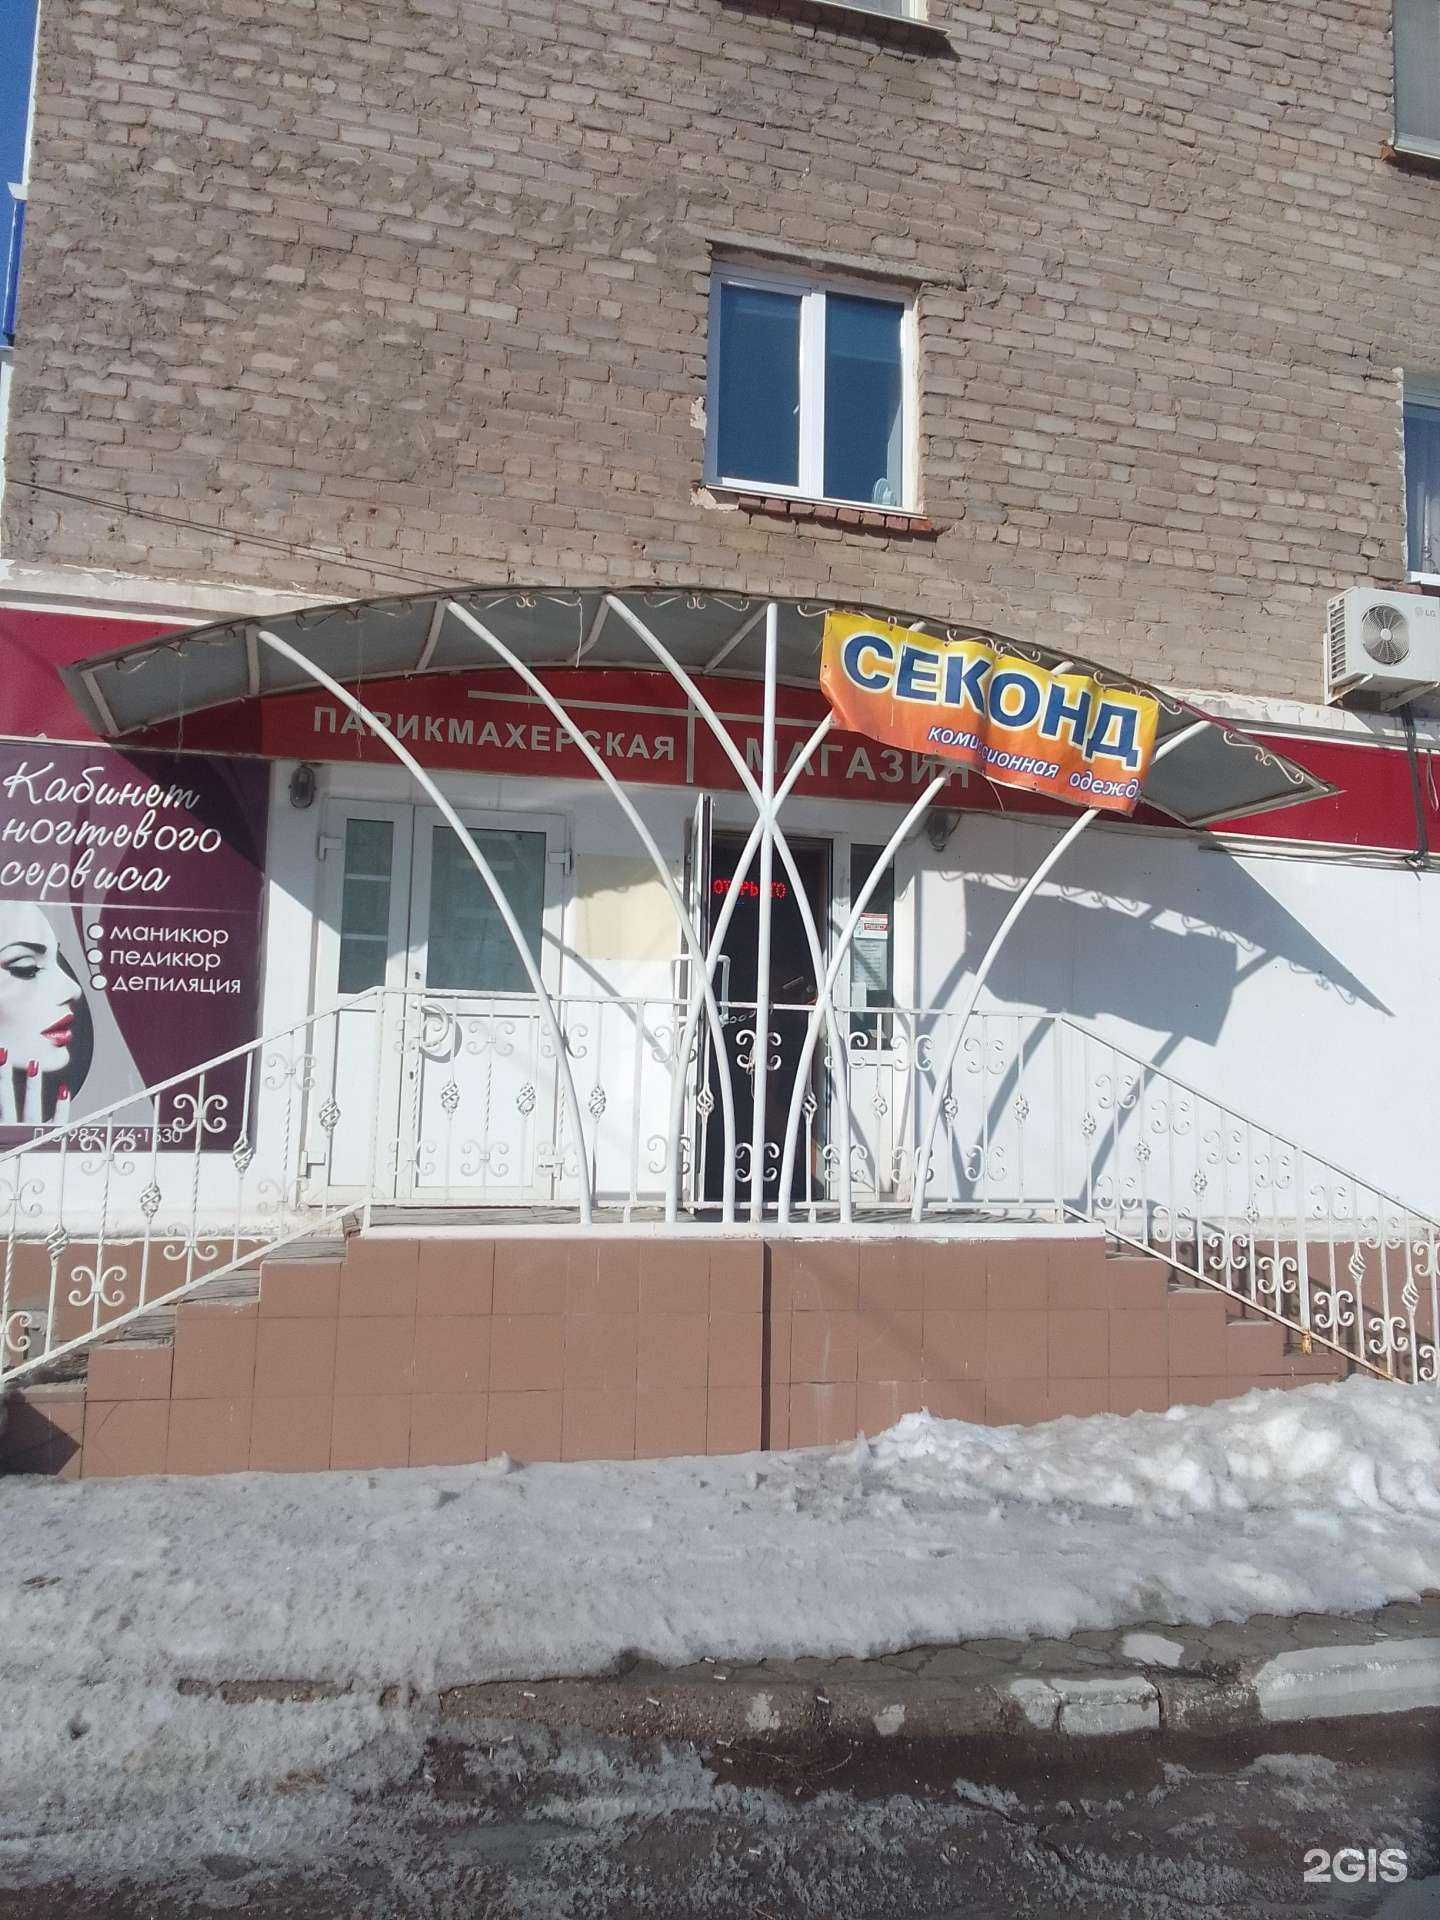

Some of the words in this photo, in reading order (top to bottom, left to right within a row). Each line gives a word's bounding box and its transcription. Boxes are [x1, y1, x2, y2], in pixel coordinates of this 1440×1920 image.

[840, 631, 1142, 768] СЕКОНД
[2, 761, 201, 810] Кабинет
[1, 809, 222, 853] ногтевого
[0, 848, 171, 901] сервиса
[110, 926, 229, 948] маникюр
[110, 950, 221, 972] педикюр
[111, 975, 241, 994] депиляция
